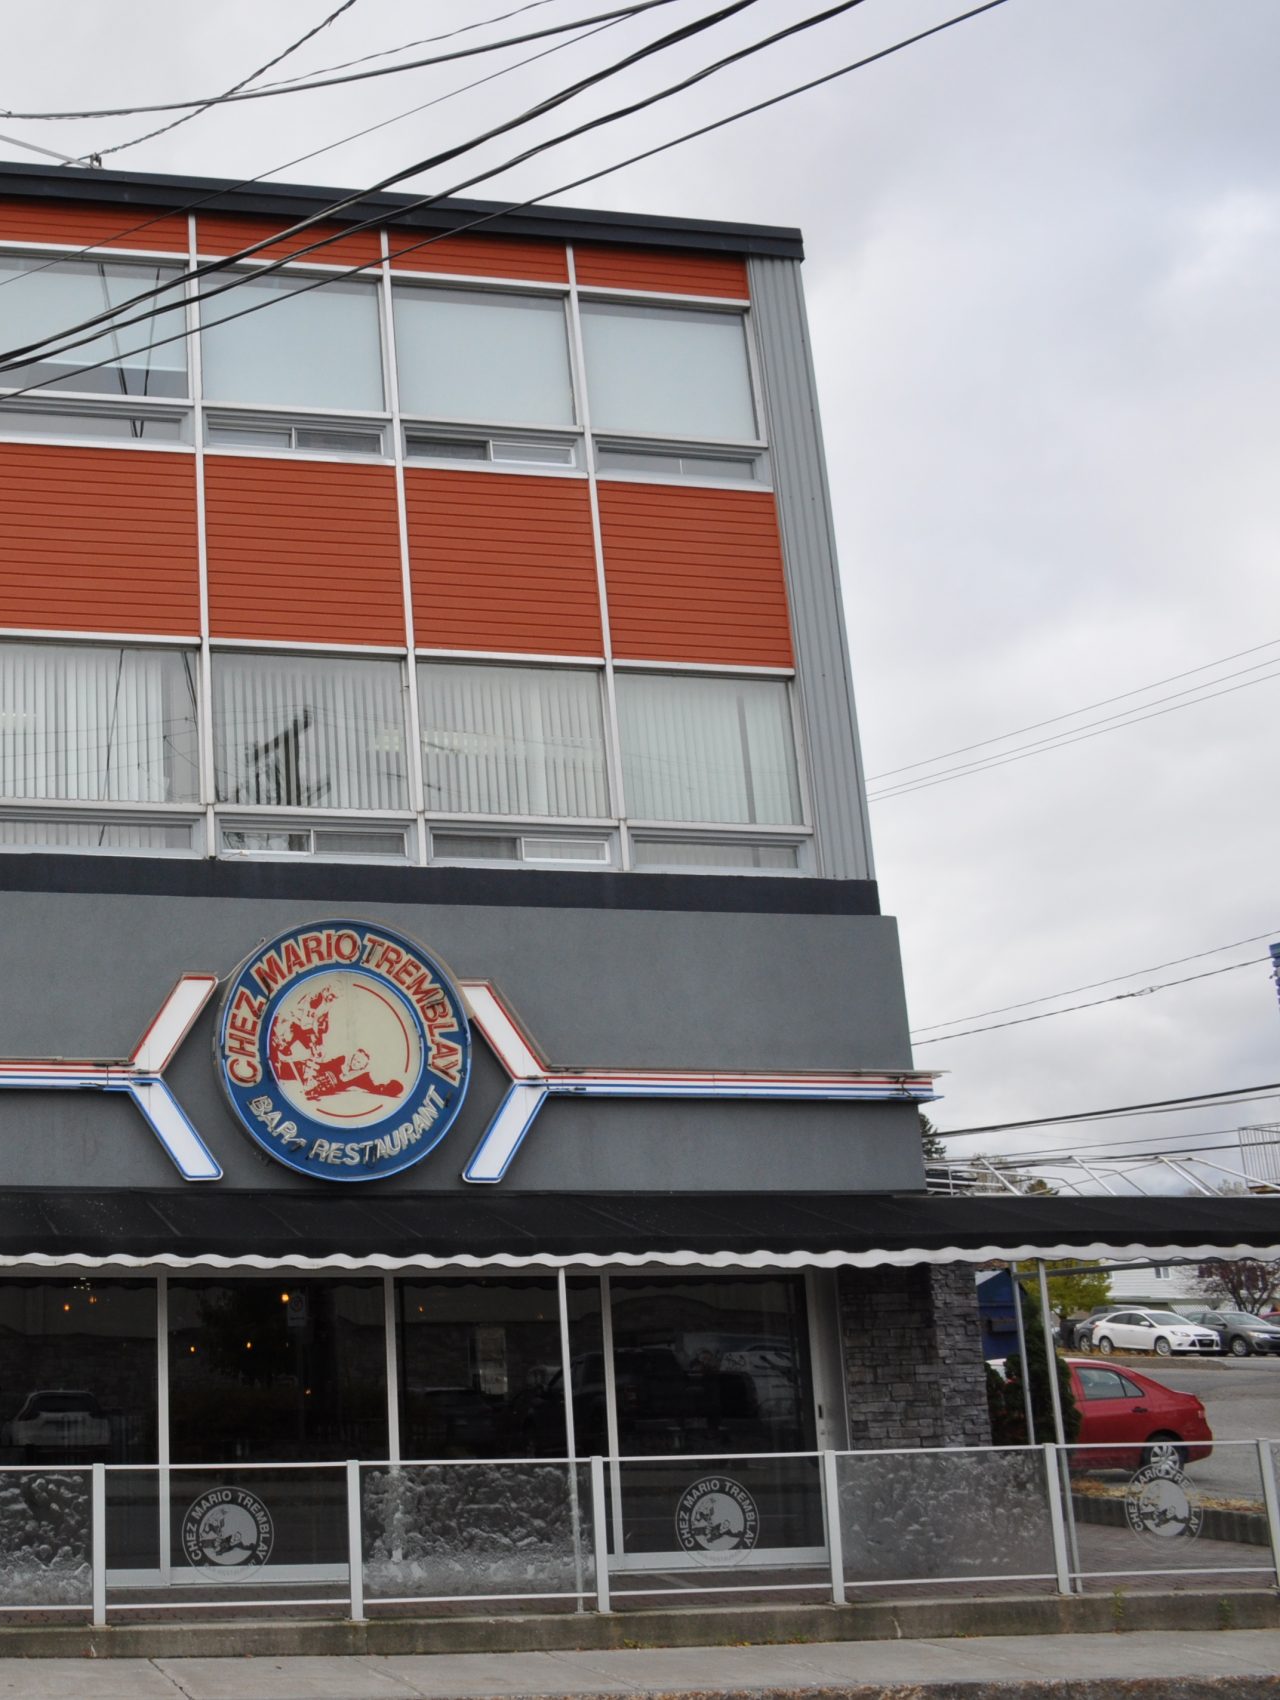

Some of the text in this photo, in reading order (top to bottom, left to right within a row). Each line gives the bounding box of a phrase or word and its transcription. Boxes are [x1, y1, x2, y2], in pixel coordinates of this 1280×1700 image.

[225, 929, 461, 1086] CHEZ MARIO TREMBLAY
[249, 1085, 445, 1165] BAR RESTAURANT
[186, 1490, 270, 1561] CHEZ MARIO TREMBLAY
[679, 1479, 756, 1548] CHEZ MARIO TREMBLAY
[1128, 1496, 1144, 1531] CHEZ
